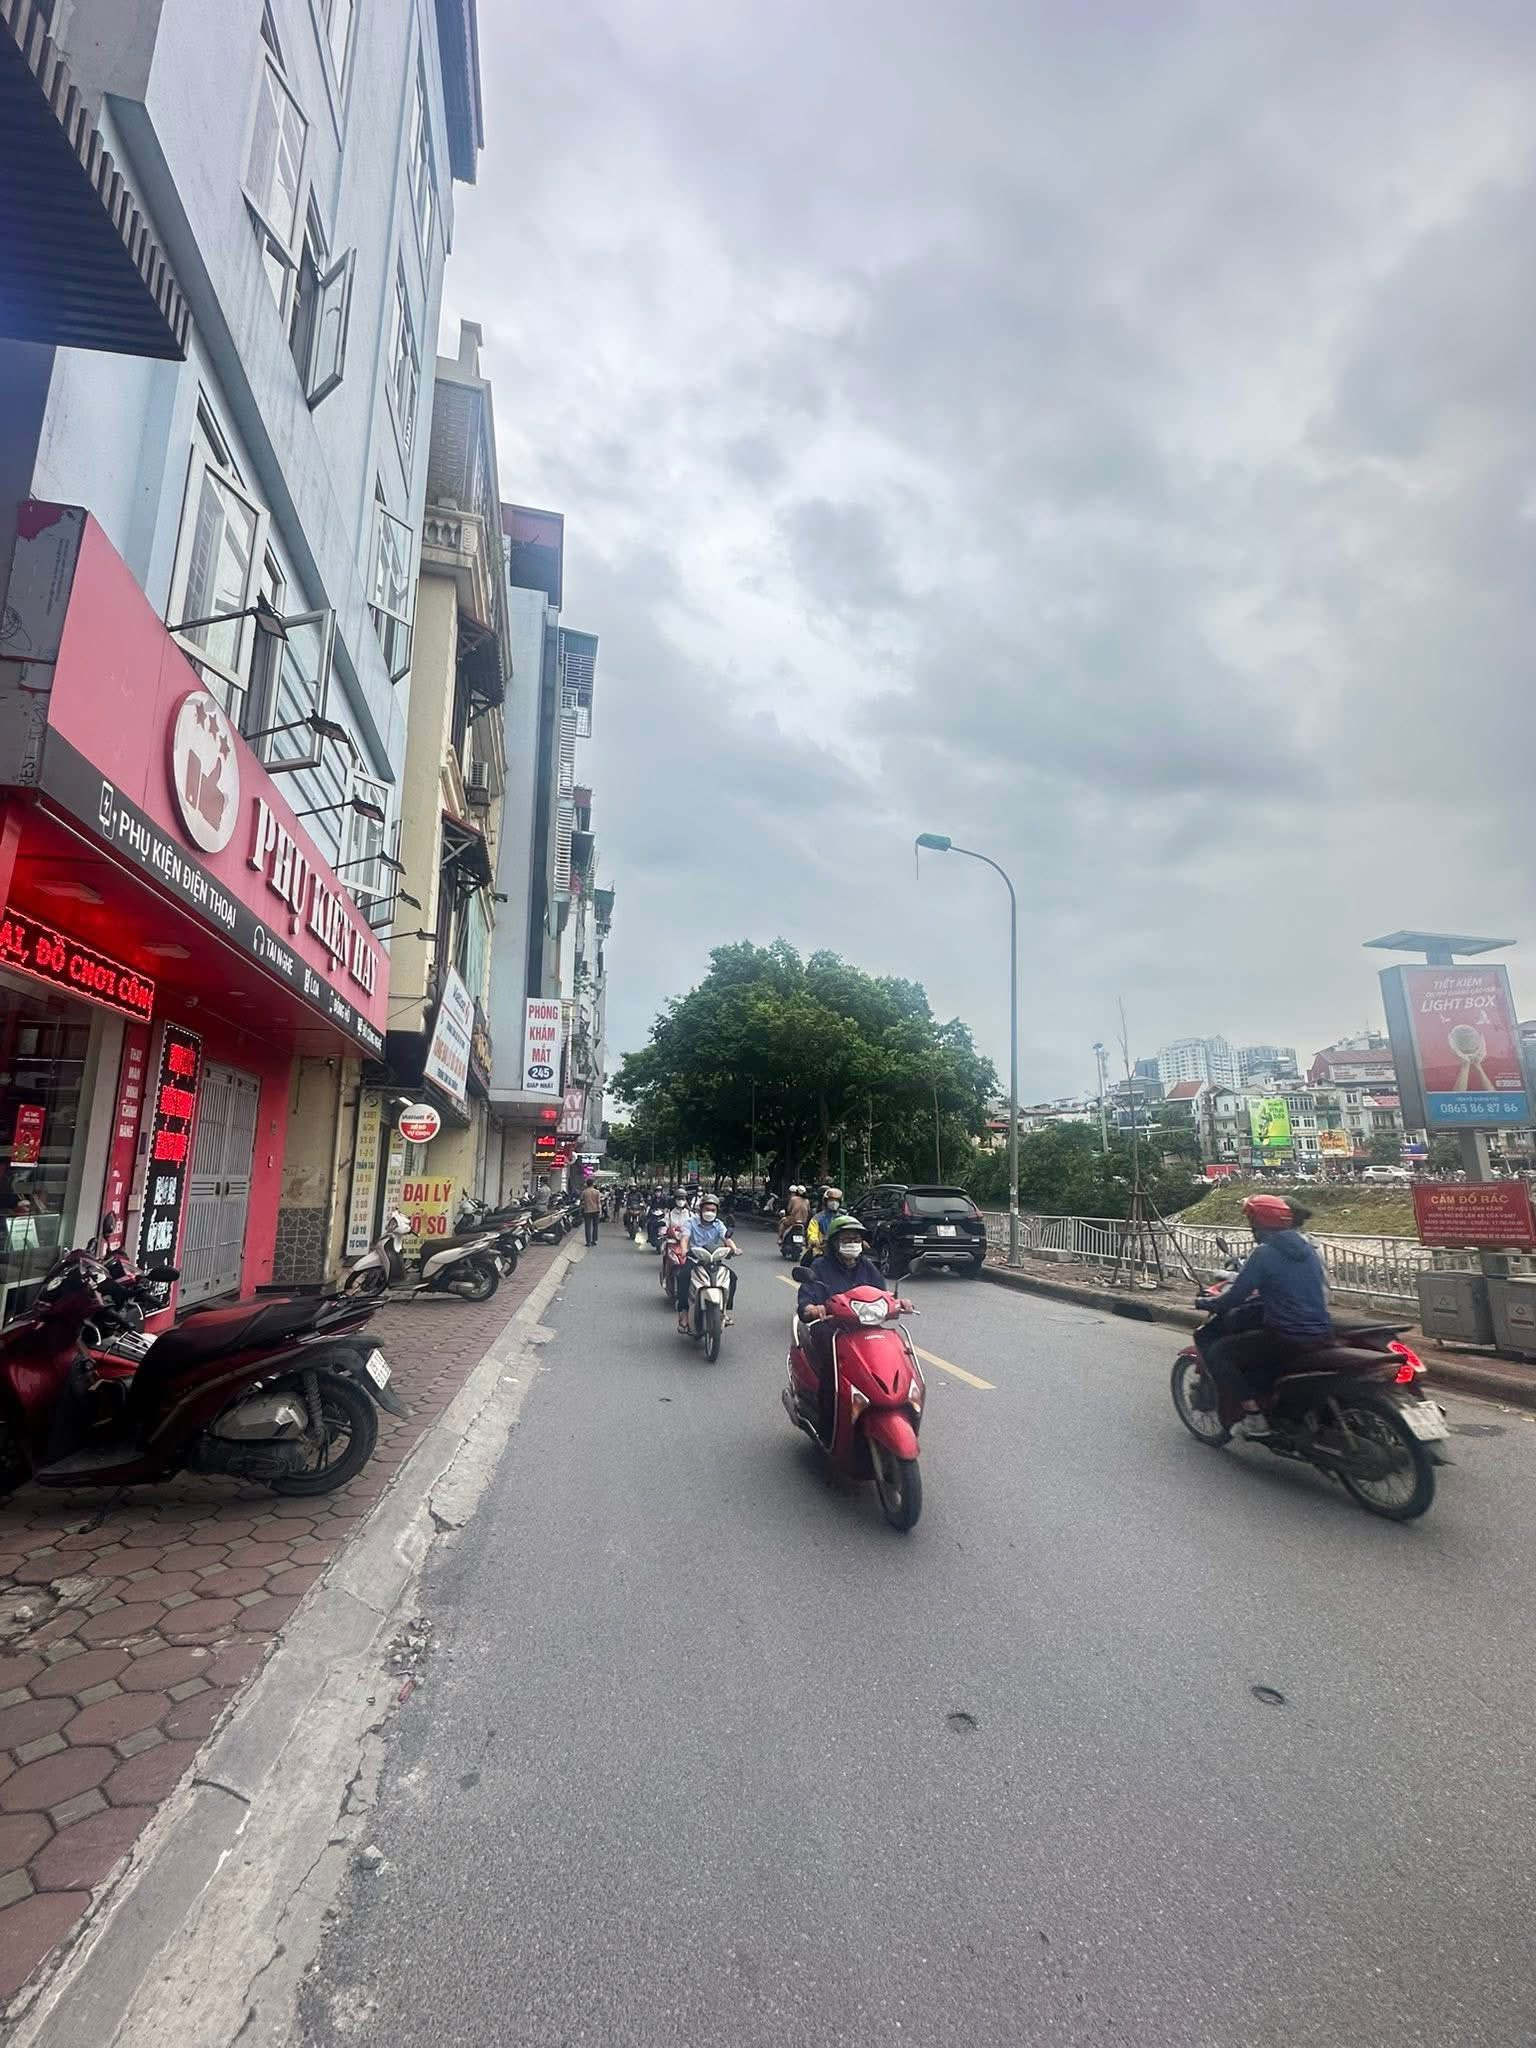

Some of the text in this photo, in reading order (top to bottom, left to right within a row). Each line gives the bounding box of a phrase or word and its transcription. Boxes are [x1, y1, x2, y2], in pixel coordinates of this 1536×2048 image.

[119, 810, 237, 929] PHỤ KIỆN ĐIỆN THOẠI
[251, 797, 379, 997] PHỤ KIỆN HAY
[36, 935, 66, 972] ĐỒ
[266, 938, 277, 962] TAI
[528, 1002, 559, 1020] PHÒNG
[1420, 994, 1497, 1013] LIGHT BOX
[529, 1024, 556, 1041] KHÁM
[531, 1067, 550, 1078] 245
[403, 1179, 452, 1206] ĐẠI LÝ
[427, 1208, 448, 1235] SỐ
